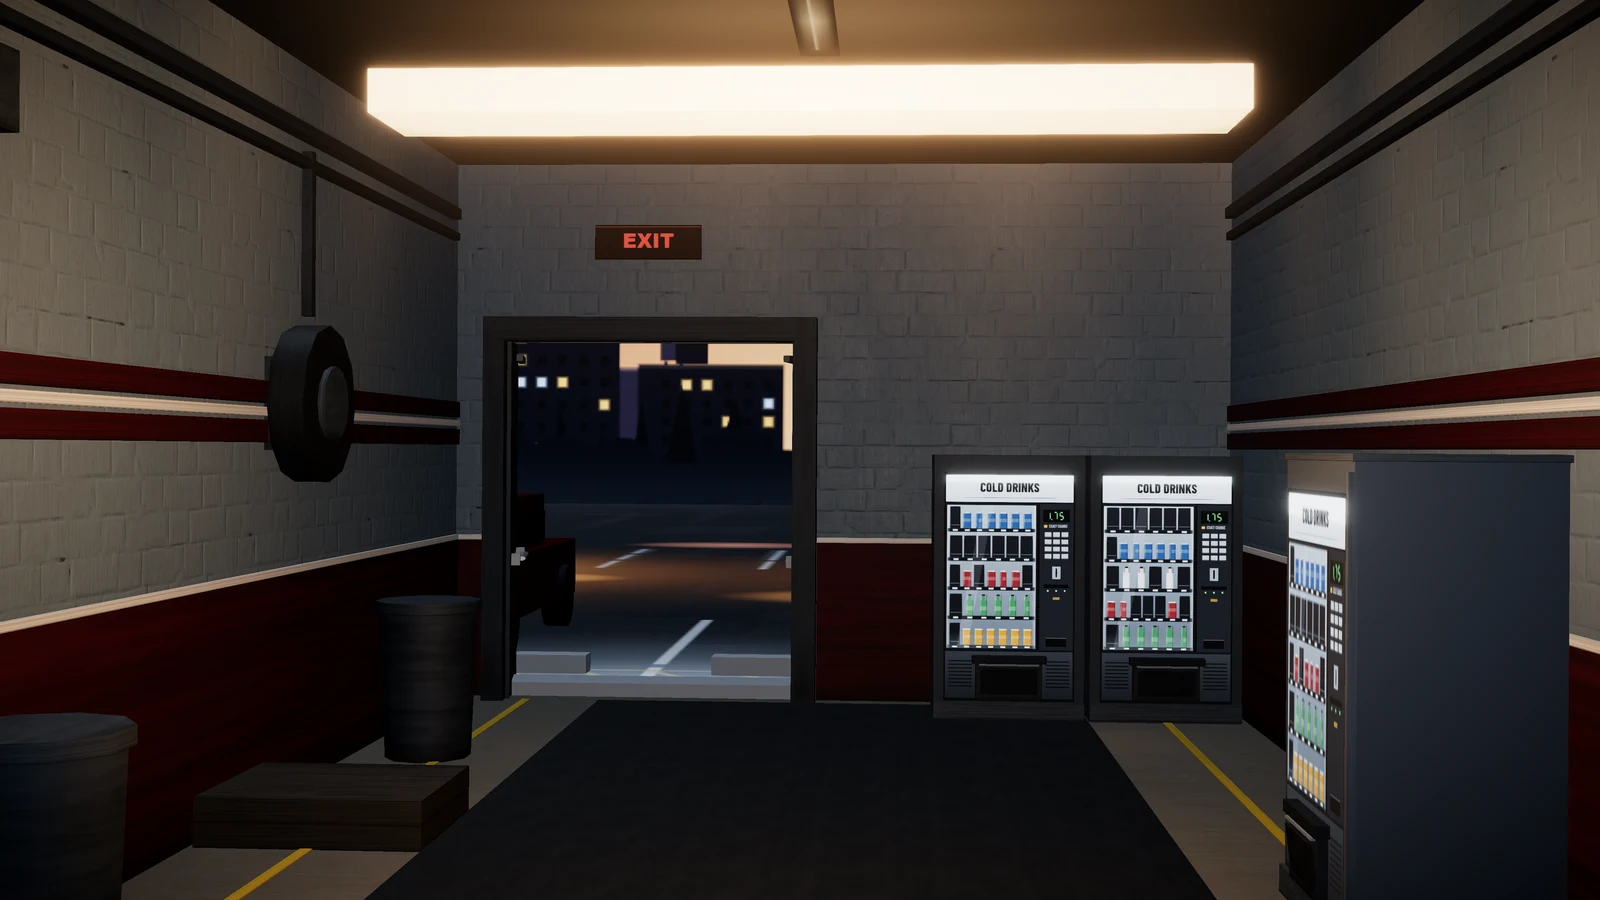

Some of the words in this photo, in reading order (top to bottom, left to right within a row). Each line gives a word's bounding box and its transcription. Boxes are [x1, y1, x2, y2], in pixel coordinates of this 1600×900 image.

[623, 232, 674, 249] EXIT
[980, 482, 1004, 493] COLD
[1006, 482, 1040, 493] DRINKS
[1137, 483, 1161, 494] COLD
[1163, 483, 1198, 494] DRINKS
[1302, 507, 1312, 525] COLD
[1313, 508, 1329, 528] DRINKS
